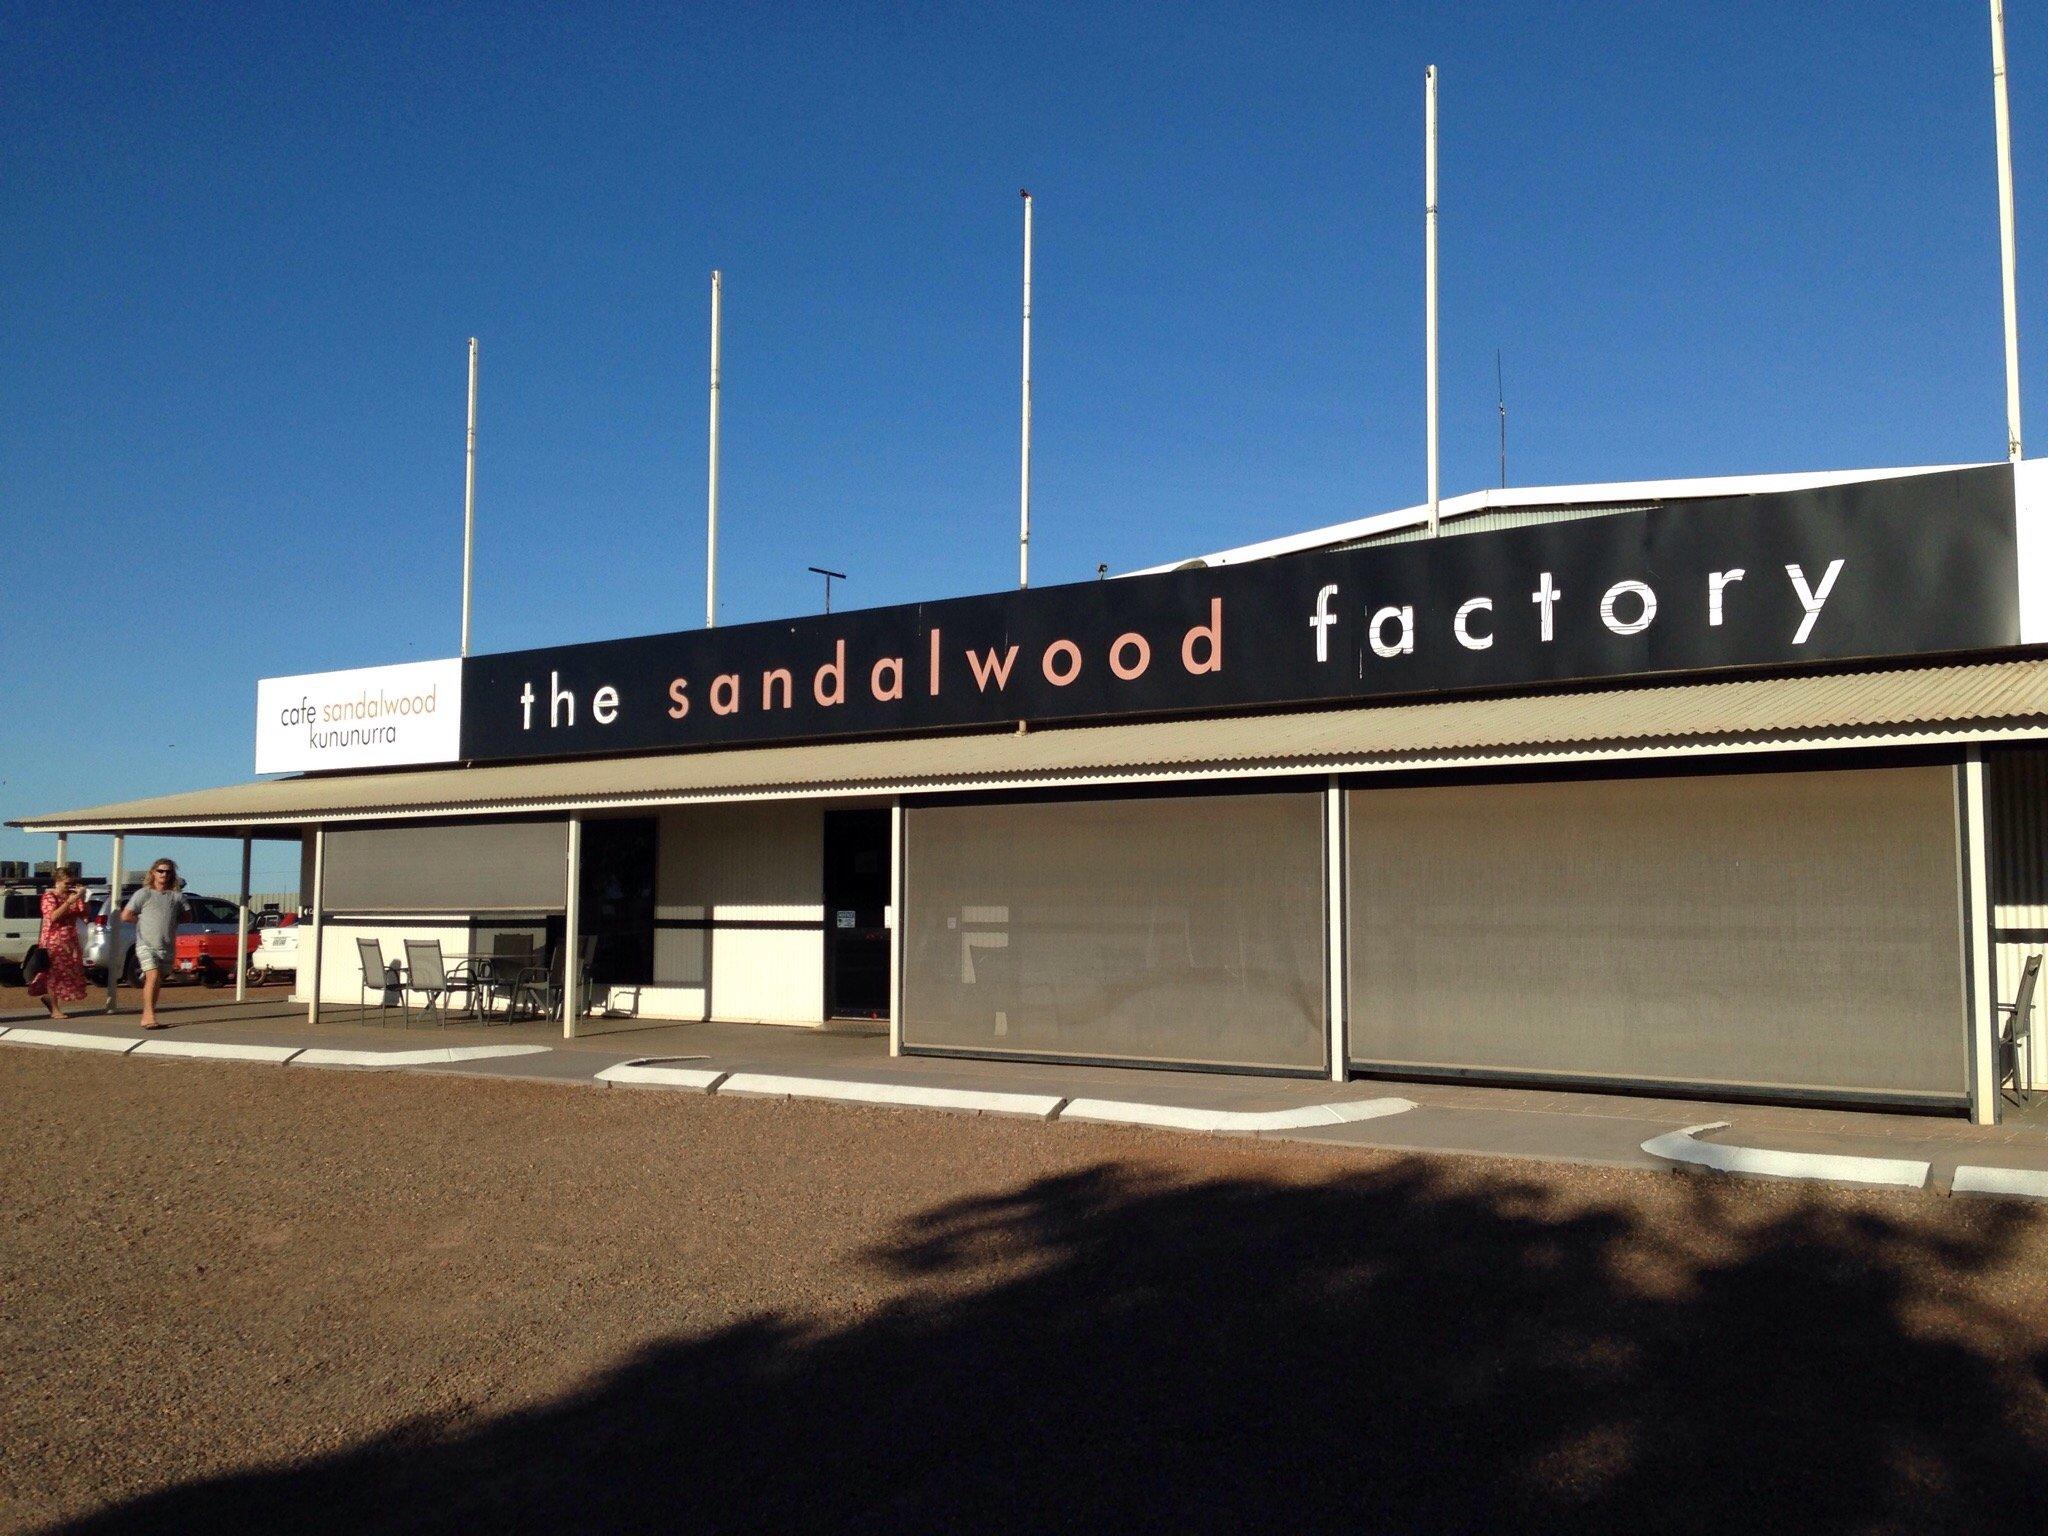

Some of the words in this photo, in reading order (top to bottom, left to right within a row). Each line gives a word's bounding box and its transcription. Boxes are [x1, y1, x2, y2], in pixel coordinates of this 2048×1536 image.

[520, 671, 619, 730] the
[667, 597, 1222, 719] sandalwood
[1309, 559, 1845, 662] factory
[281, 696, 316, 726] cafe
[323, 684, 436, 723] sandalwood
[309, 723, 396, 749] kununurra
